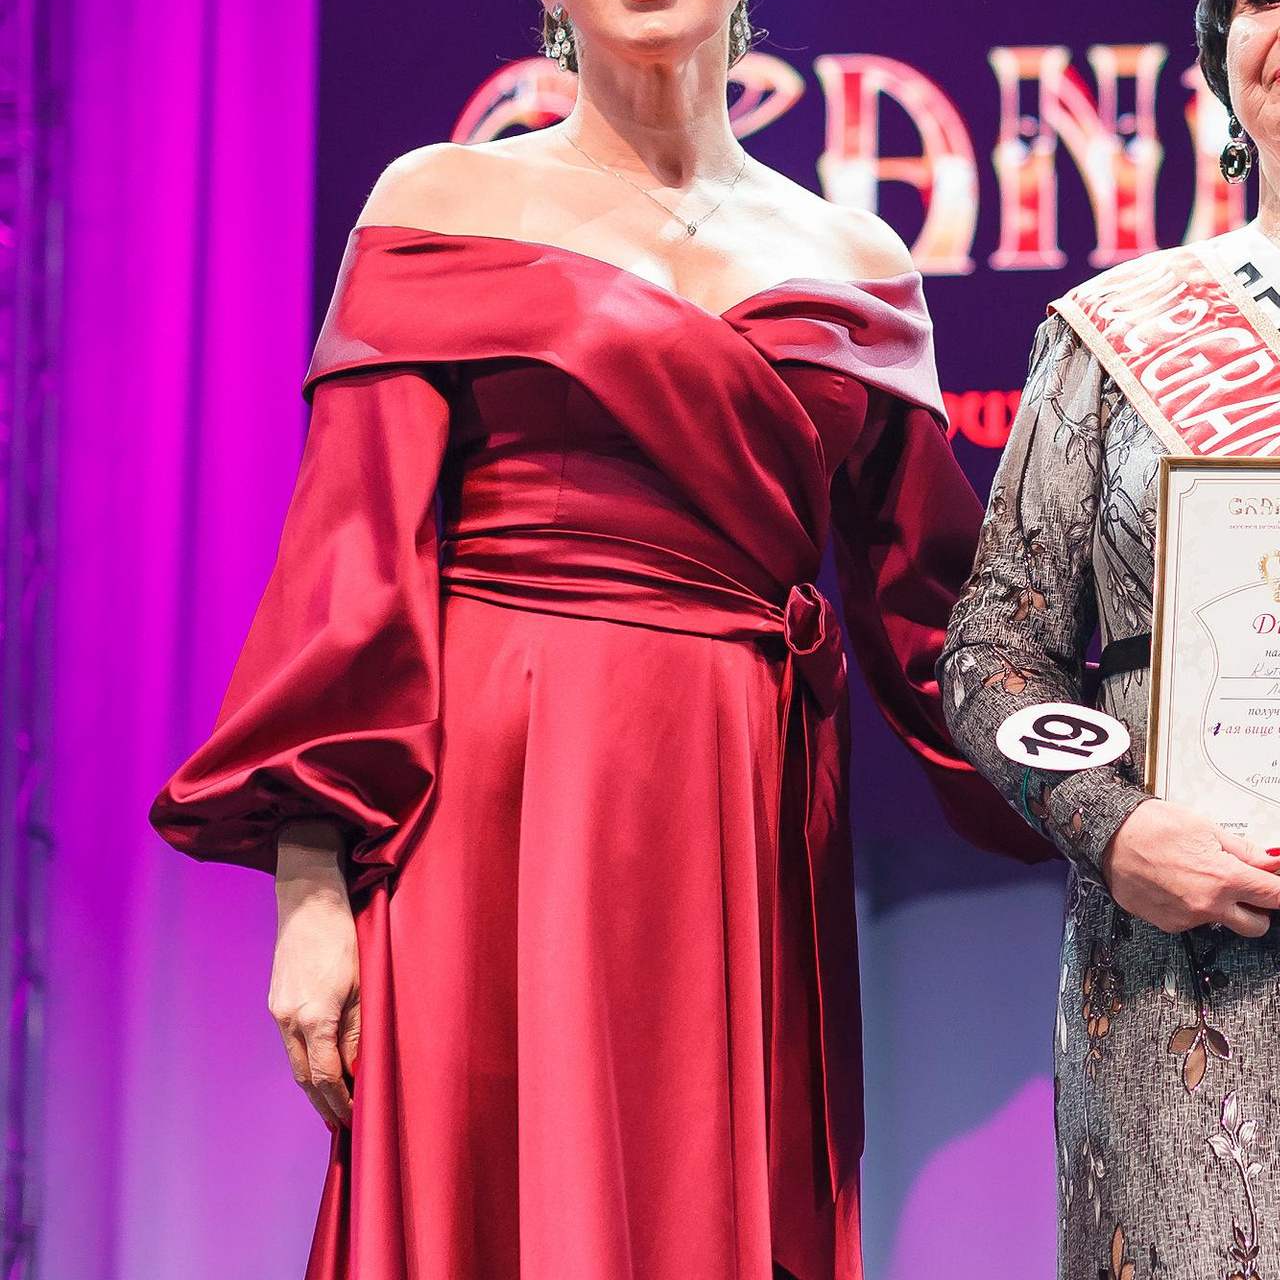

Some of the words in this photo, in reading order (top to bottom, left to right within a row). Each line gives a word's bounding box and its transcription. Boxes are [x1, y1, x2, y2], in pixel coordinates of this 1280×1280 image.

[1019, 714, 1109, 758] 19
[1244, 725, 1273, 737] вице
[1271, 758, 1278, 767] в
